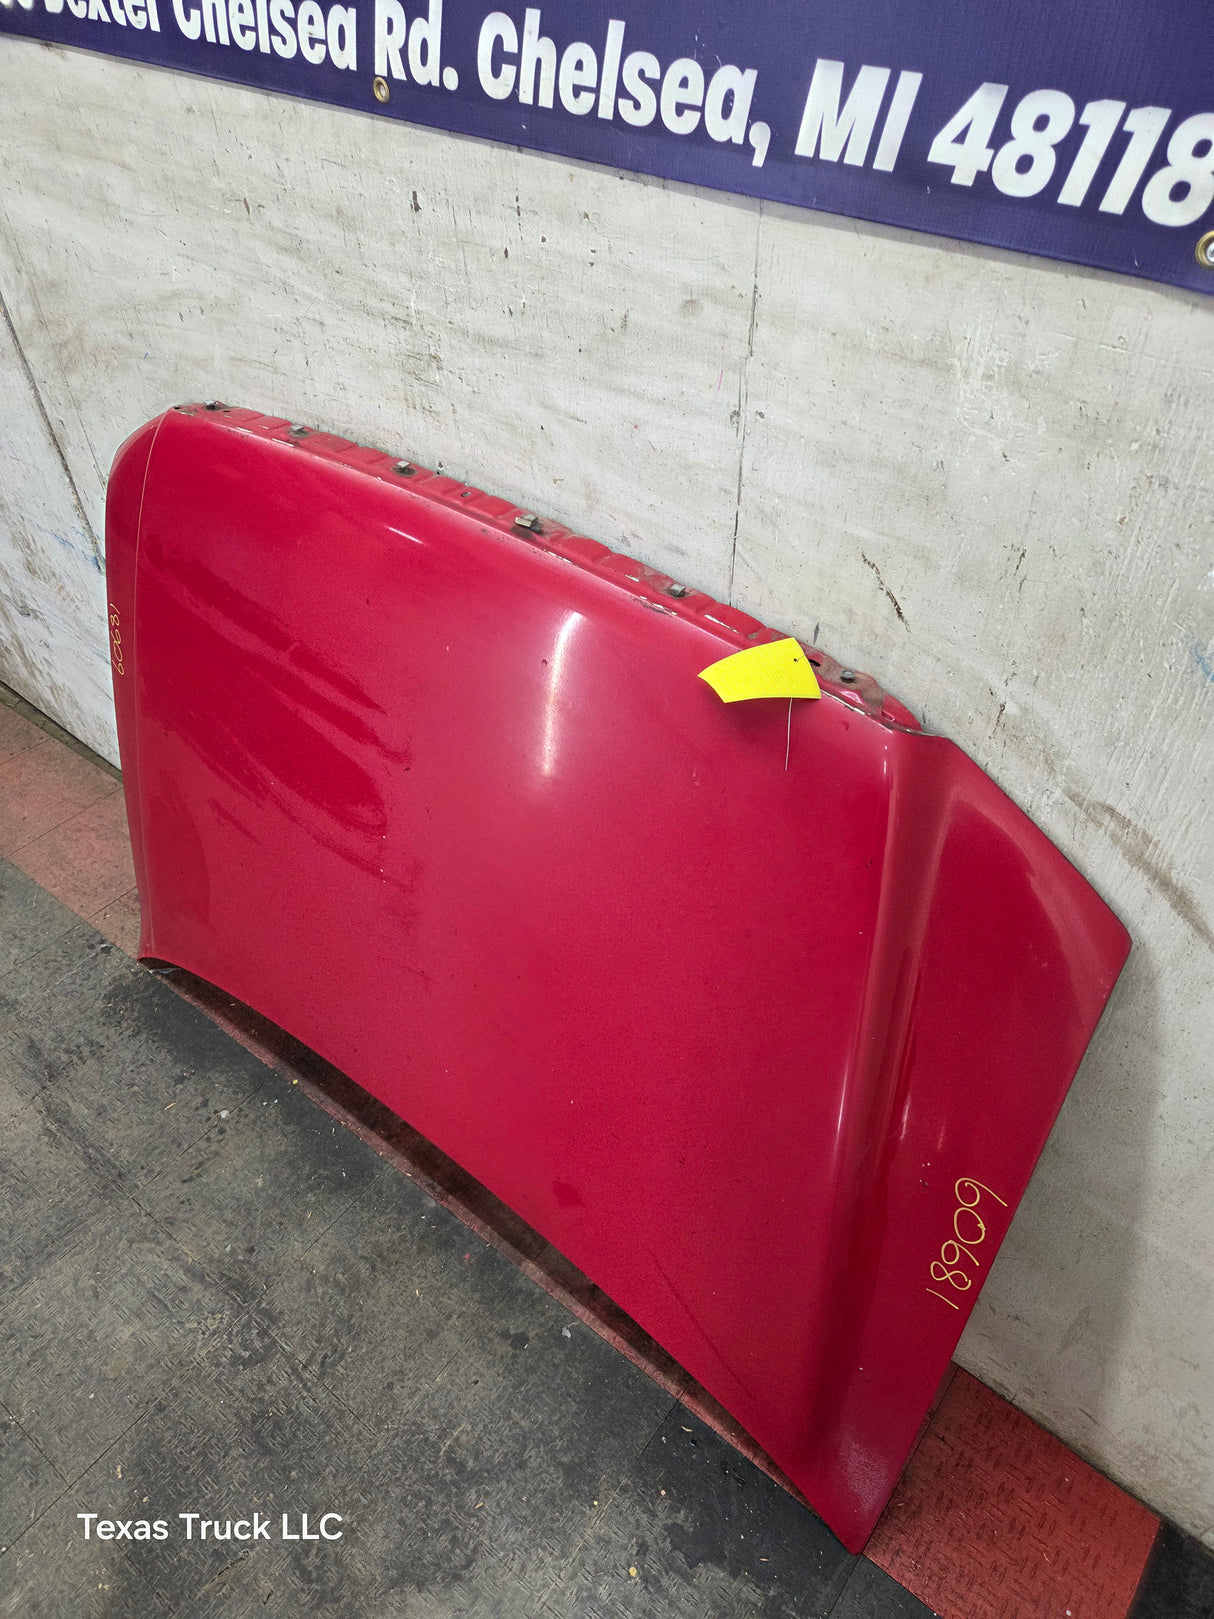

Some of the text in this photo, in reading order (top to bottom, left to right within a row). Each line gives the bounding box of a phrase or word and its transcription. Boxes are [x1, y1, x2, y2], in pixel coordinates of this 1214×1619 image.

[374, 0, 459, 91] Rd.
[477, 7, 772, 168] Chelsea,
[794, 58, 923, 172] MI
[927, 82, 1214, 227] 48118
[109, 603, 125, 676] 18909
[925, 1177, 1008, 1310] 18909
